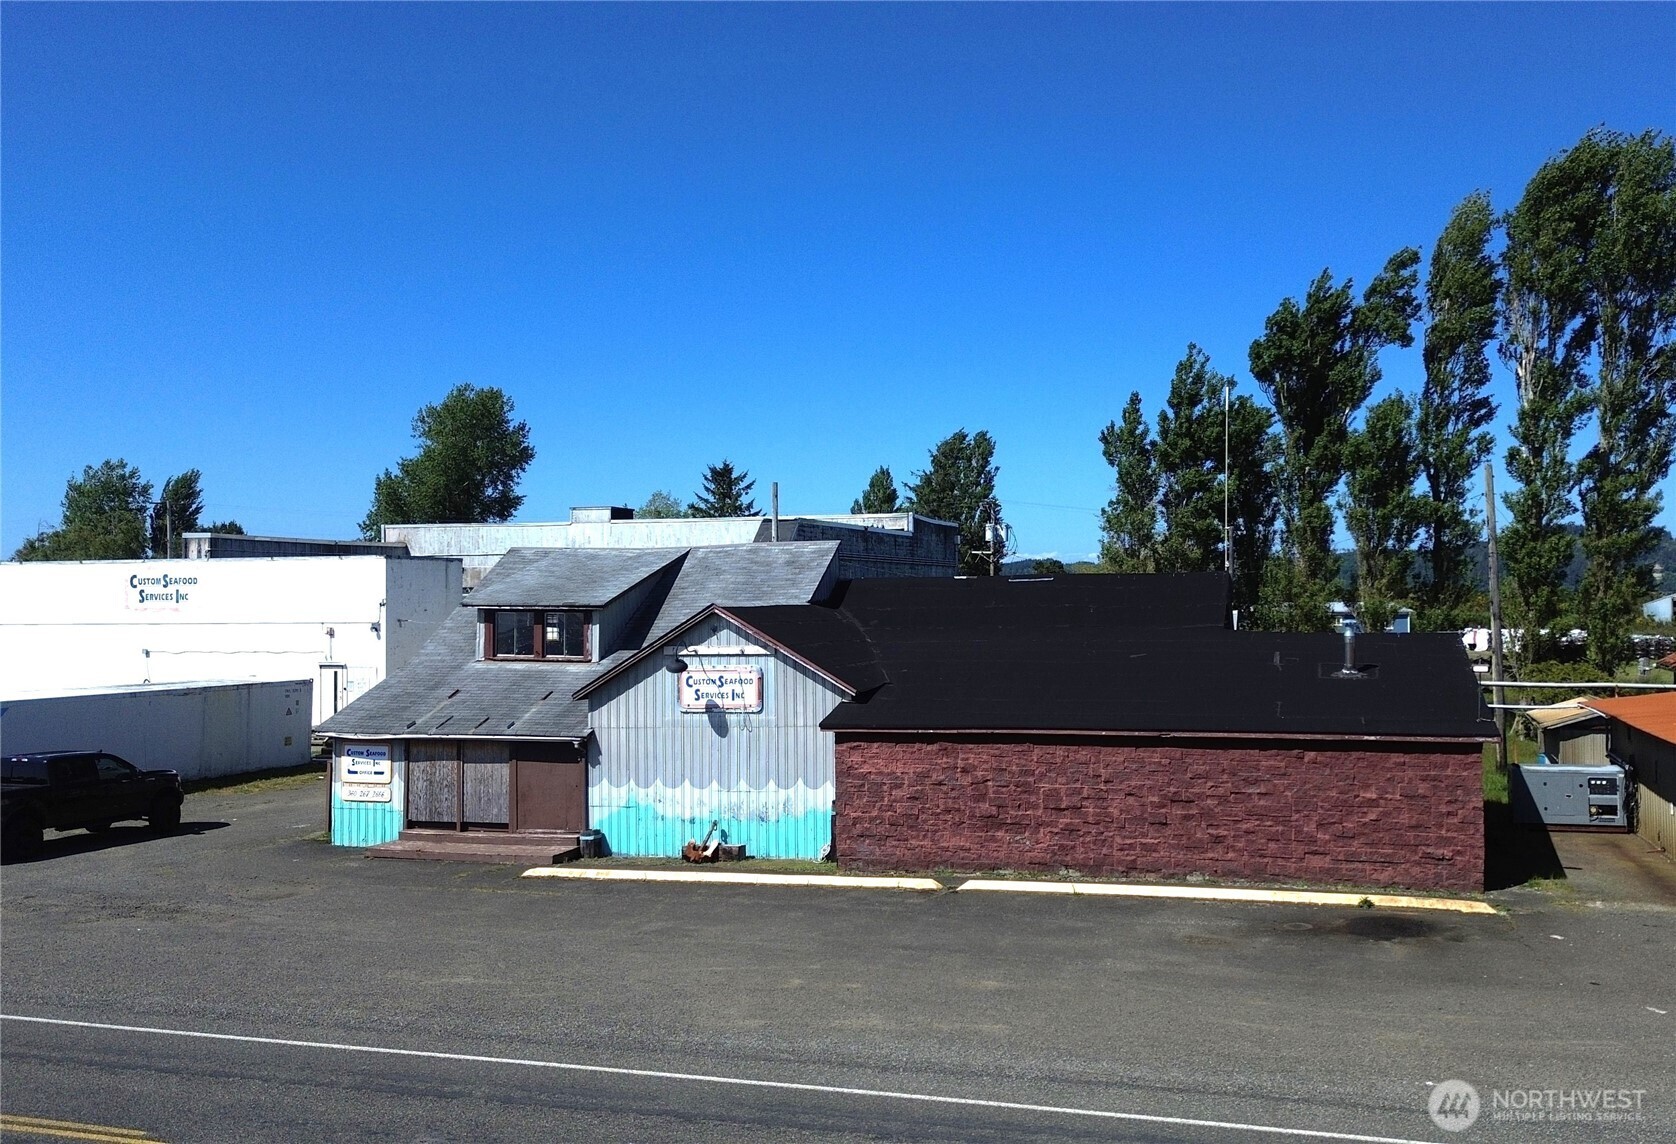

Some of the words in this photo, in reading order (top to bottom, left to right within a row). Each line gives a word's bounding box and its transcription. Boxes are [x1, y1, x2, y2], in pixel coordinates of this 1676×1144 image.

[130, 574, 161, 588] CUSTOM
[163, 574, 198, 588] SEAFOOD
[139, 589, 173, 603] SERVICES
[176, 589, 188, 603] INC
[686, 675, 717, 688] CUSTOM
[718, 675, 754, 688] SEAFOOD
[694, 688, 729, 701] SERVICES
[732, 688, 745, 701] INC
[346, 748, 364, 757] CUSTOM
[365, 749, 387, 757] SEAFOOD
[352, 758, 371, 766] SERVICES
[373, 759, 381, 767] INC
